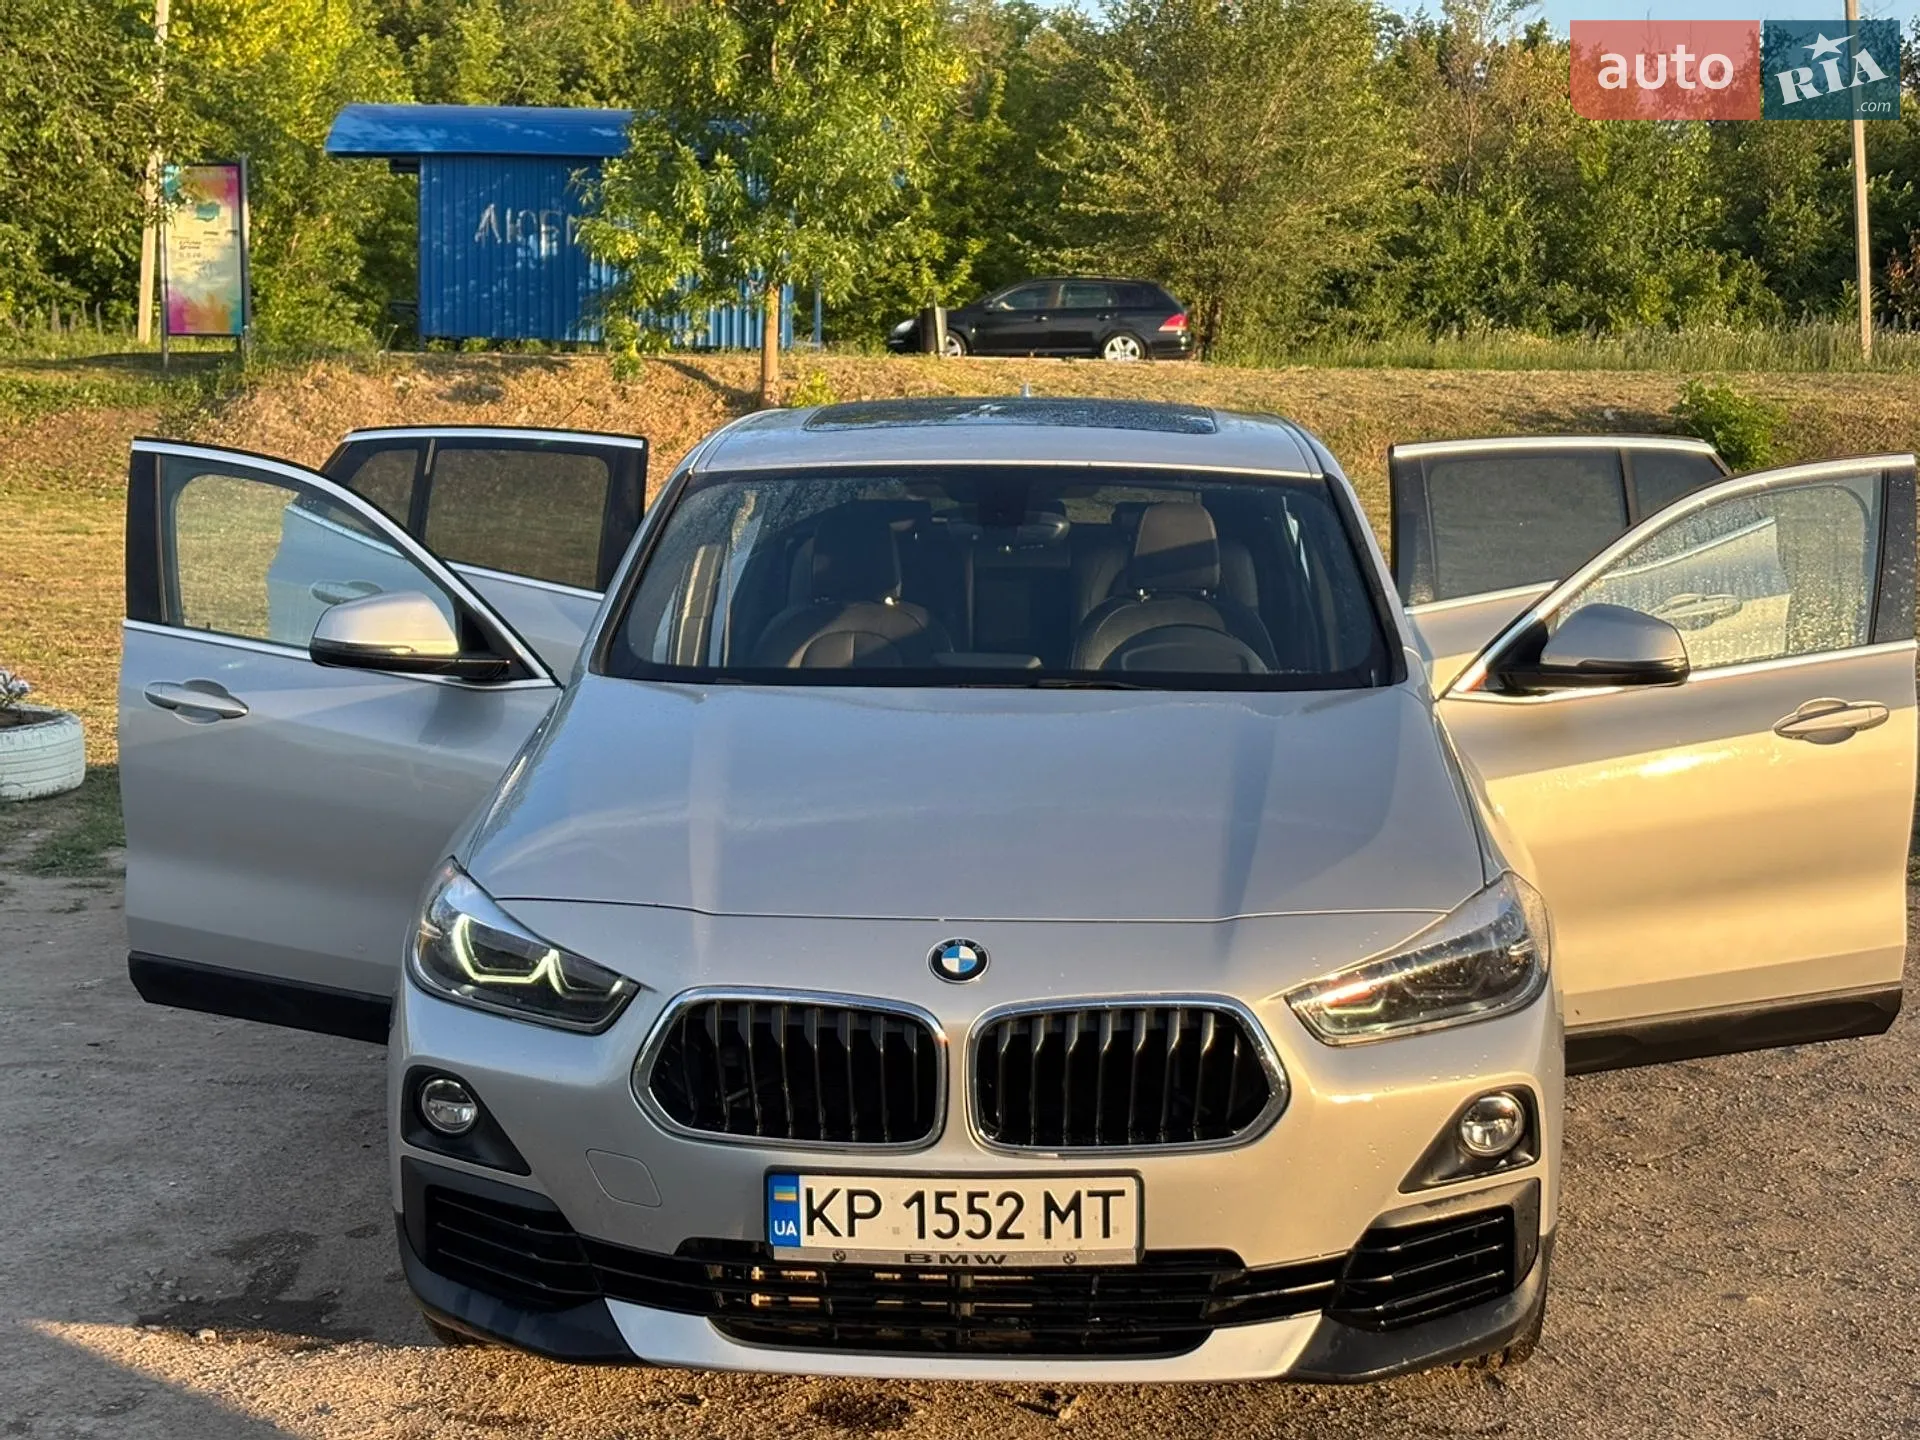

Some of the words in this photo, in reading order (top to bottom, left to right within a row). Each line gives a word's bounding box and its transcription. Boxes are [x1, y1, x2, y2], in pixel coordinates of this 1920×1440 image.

[805, 1187, 883, 1238] KP
[903, 1189, 1026, 1240] 1552
[1043, 1189, 1126, 1240] MT
[774, 1220, 798, 1237] UA
[904, 1252, 1008, 1266] BMW
